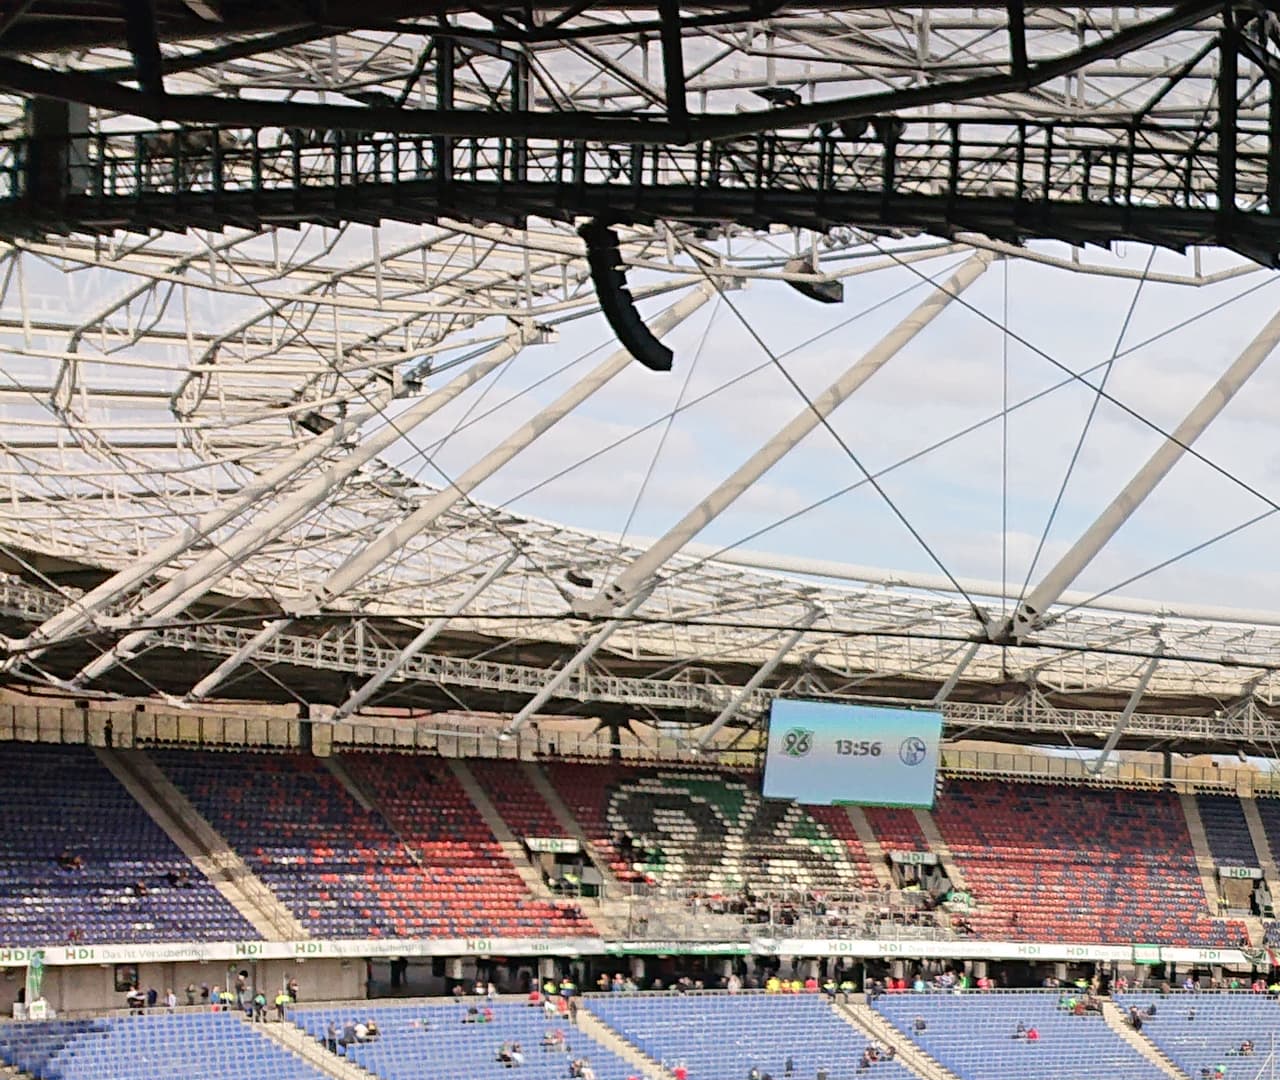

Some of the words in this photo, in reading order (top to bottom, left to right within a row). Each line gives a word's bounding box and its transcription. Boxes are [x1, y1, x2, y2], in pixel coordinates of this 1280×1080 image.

[834, 739, 881, 757] 13:56
[1230, 868, 1252, 877] HDI
[235, 944, 263, 955] HDI
[295, 943, 323, 953] HDI
[466, 941, 492, 952] HDI
[828, 942, 853, 952] HDI
[65, 949, 95, 960] HDI
